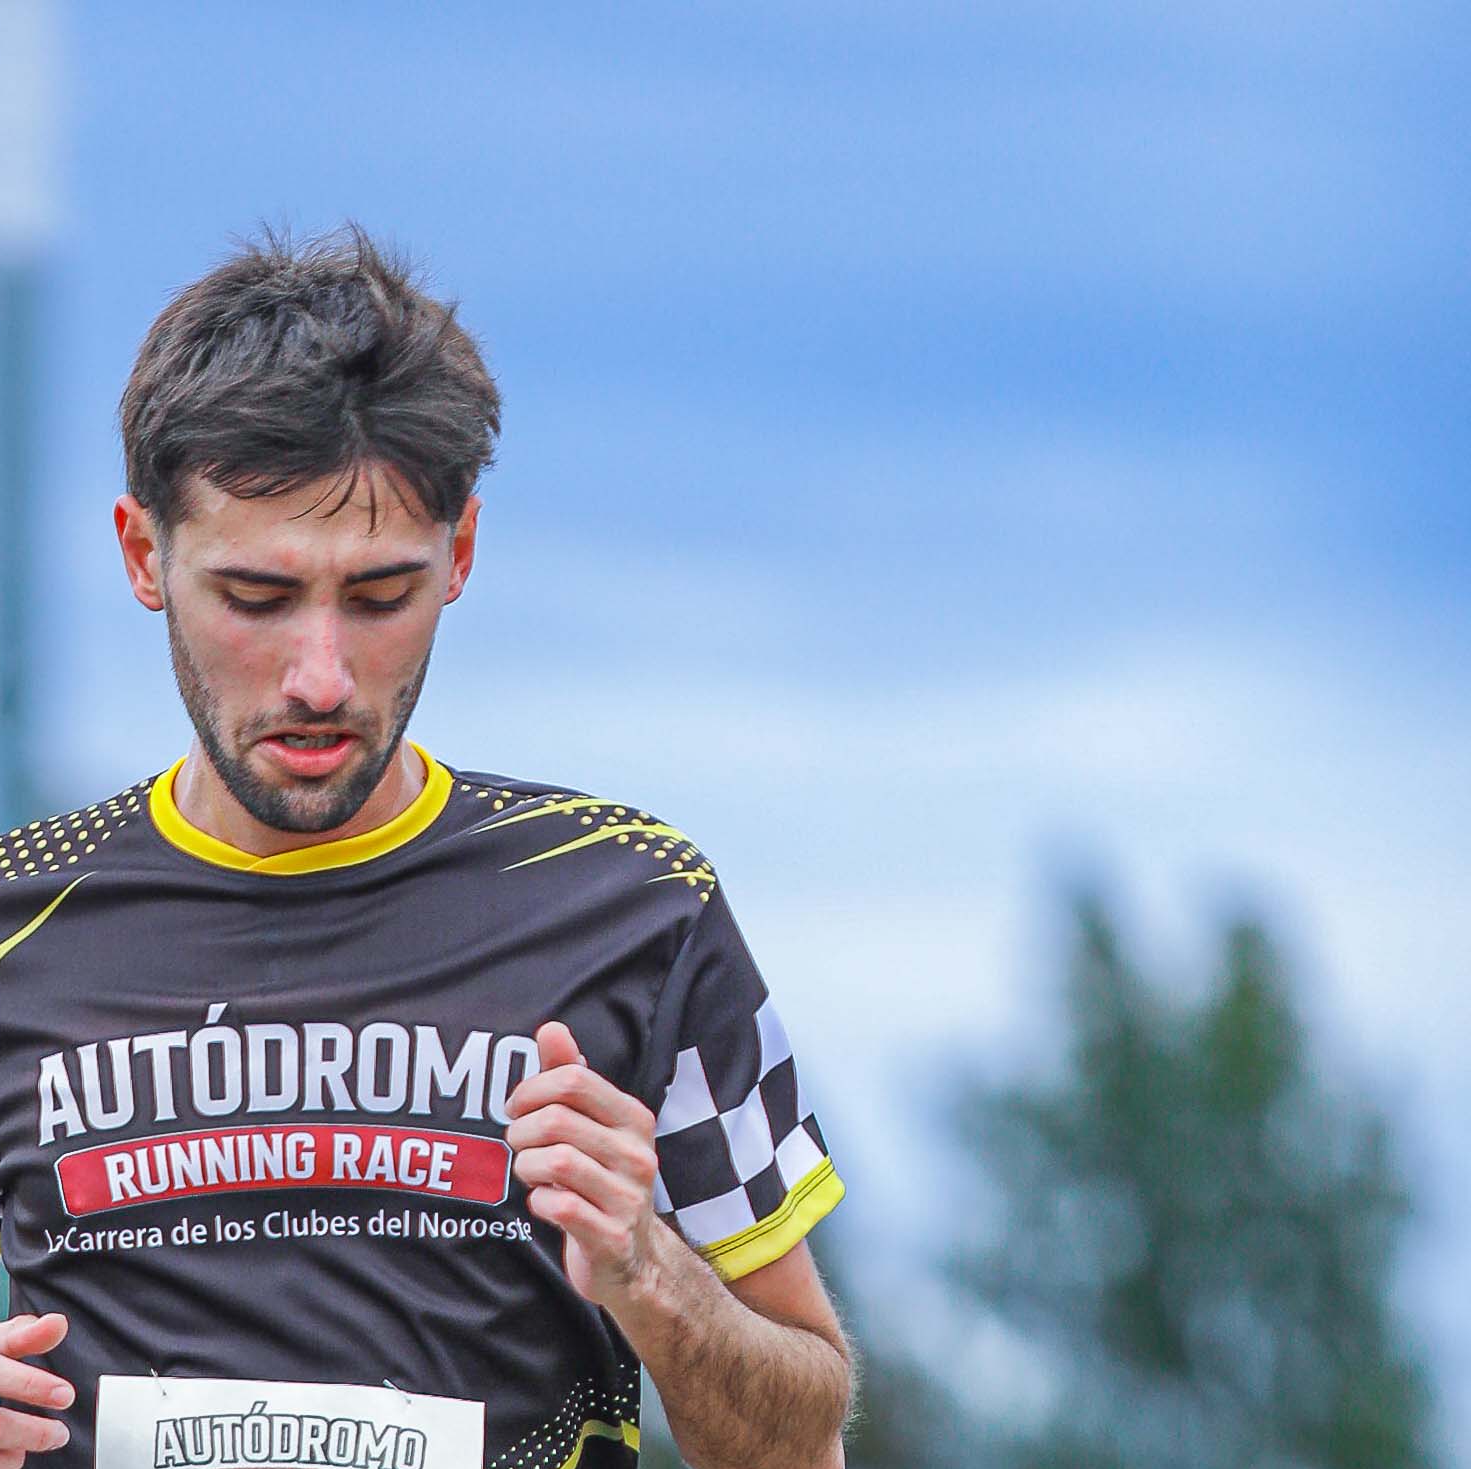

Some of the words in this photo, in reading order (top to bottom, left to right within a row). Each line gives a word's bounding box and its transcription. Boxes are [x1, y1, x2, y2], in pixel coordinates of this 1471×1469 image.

[38, 1002, 542, 1147] AUTÓDROMO
[103, 1132, 317, 1203] RUNNING
[331, 1132, 460, 1192] RACE
[64, 1226, 164, 1253] Carrera
[170, 1217, 209, 1246] de
[215, 1214, 257, 1243] los
[262, 1209, 360, 1239] Clubes
[367, 1208, 410, 1238] del
[417, 1211, 534, 1242] Noroeste
